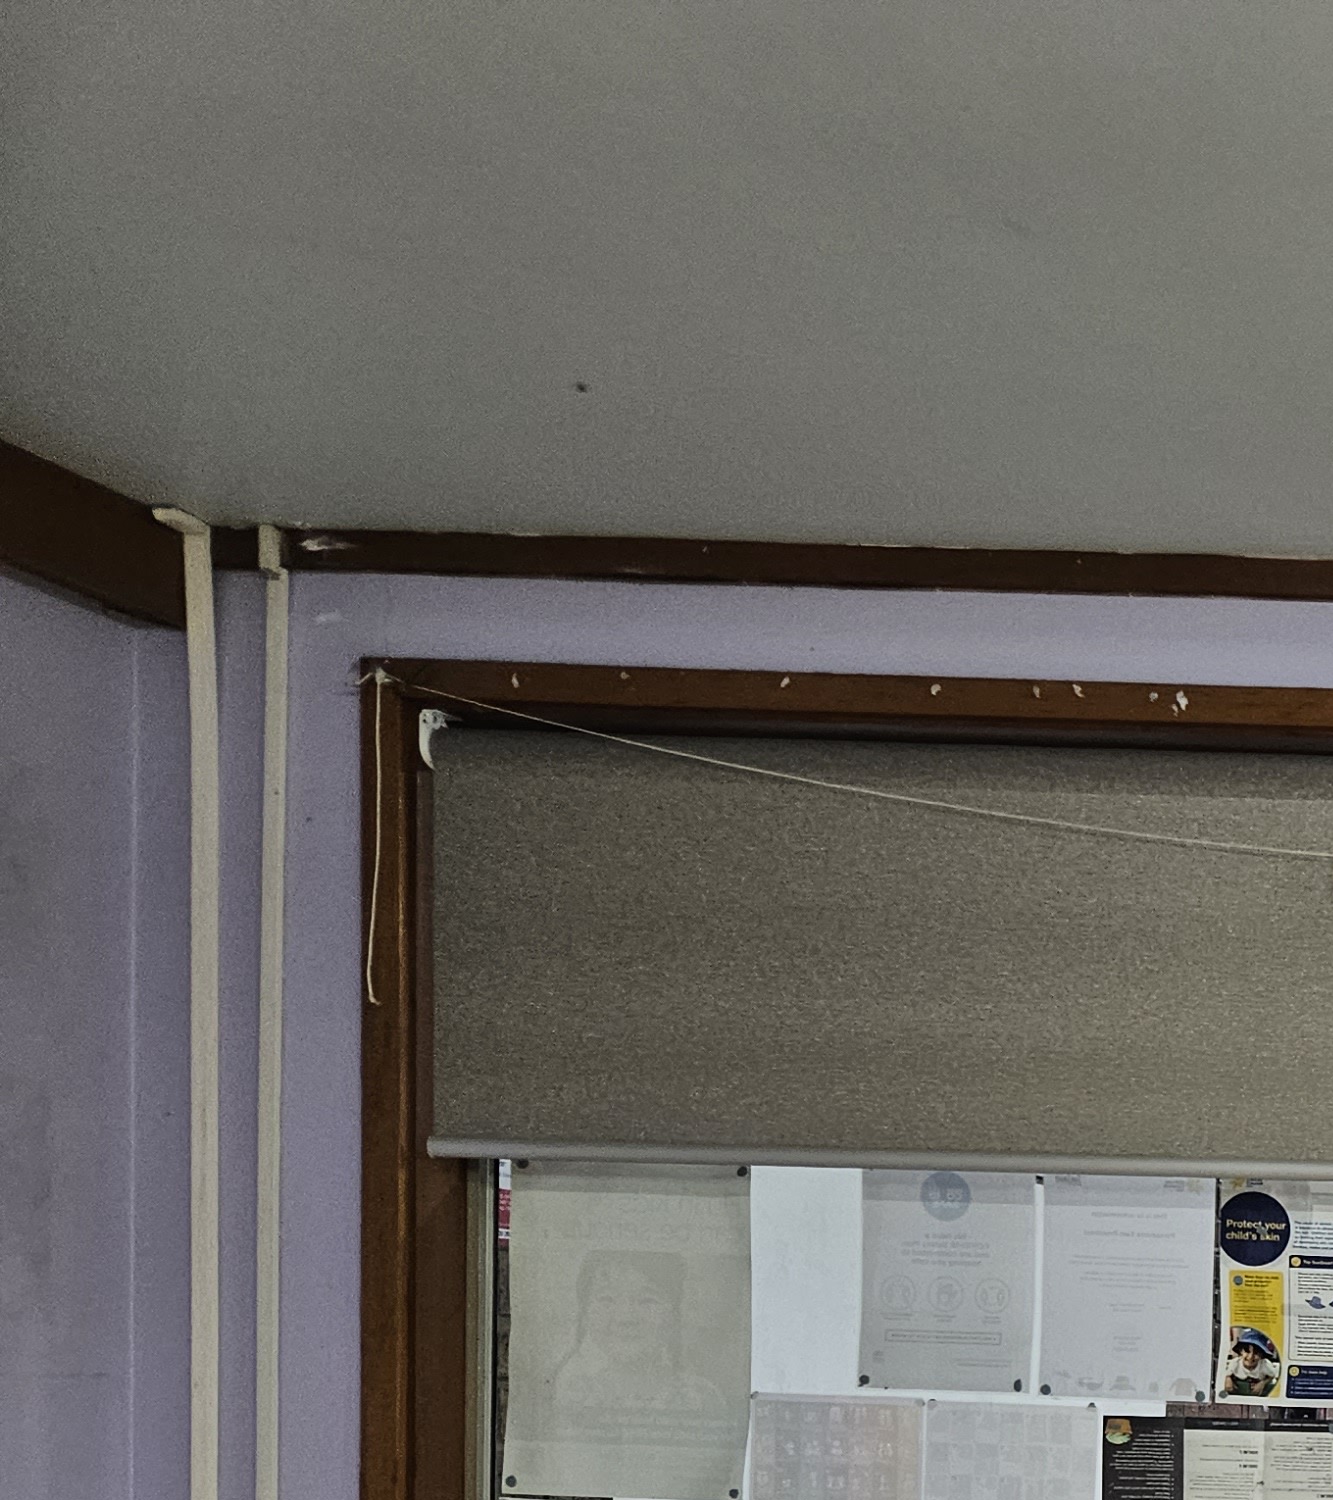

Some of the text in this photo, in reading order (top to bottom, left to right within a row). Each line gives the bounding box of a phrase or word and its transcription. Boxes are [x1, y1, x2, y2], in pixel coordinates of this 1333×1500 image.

[1226, 1219, 1286, 1230] Protect your
[1226, 1231, 1257, 1240] child's
